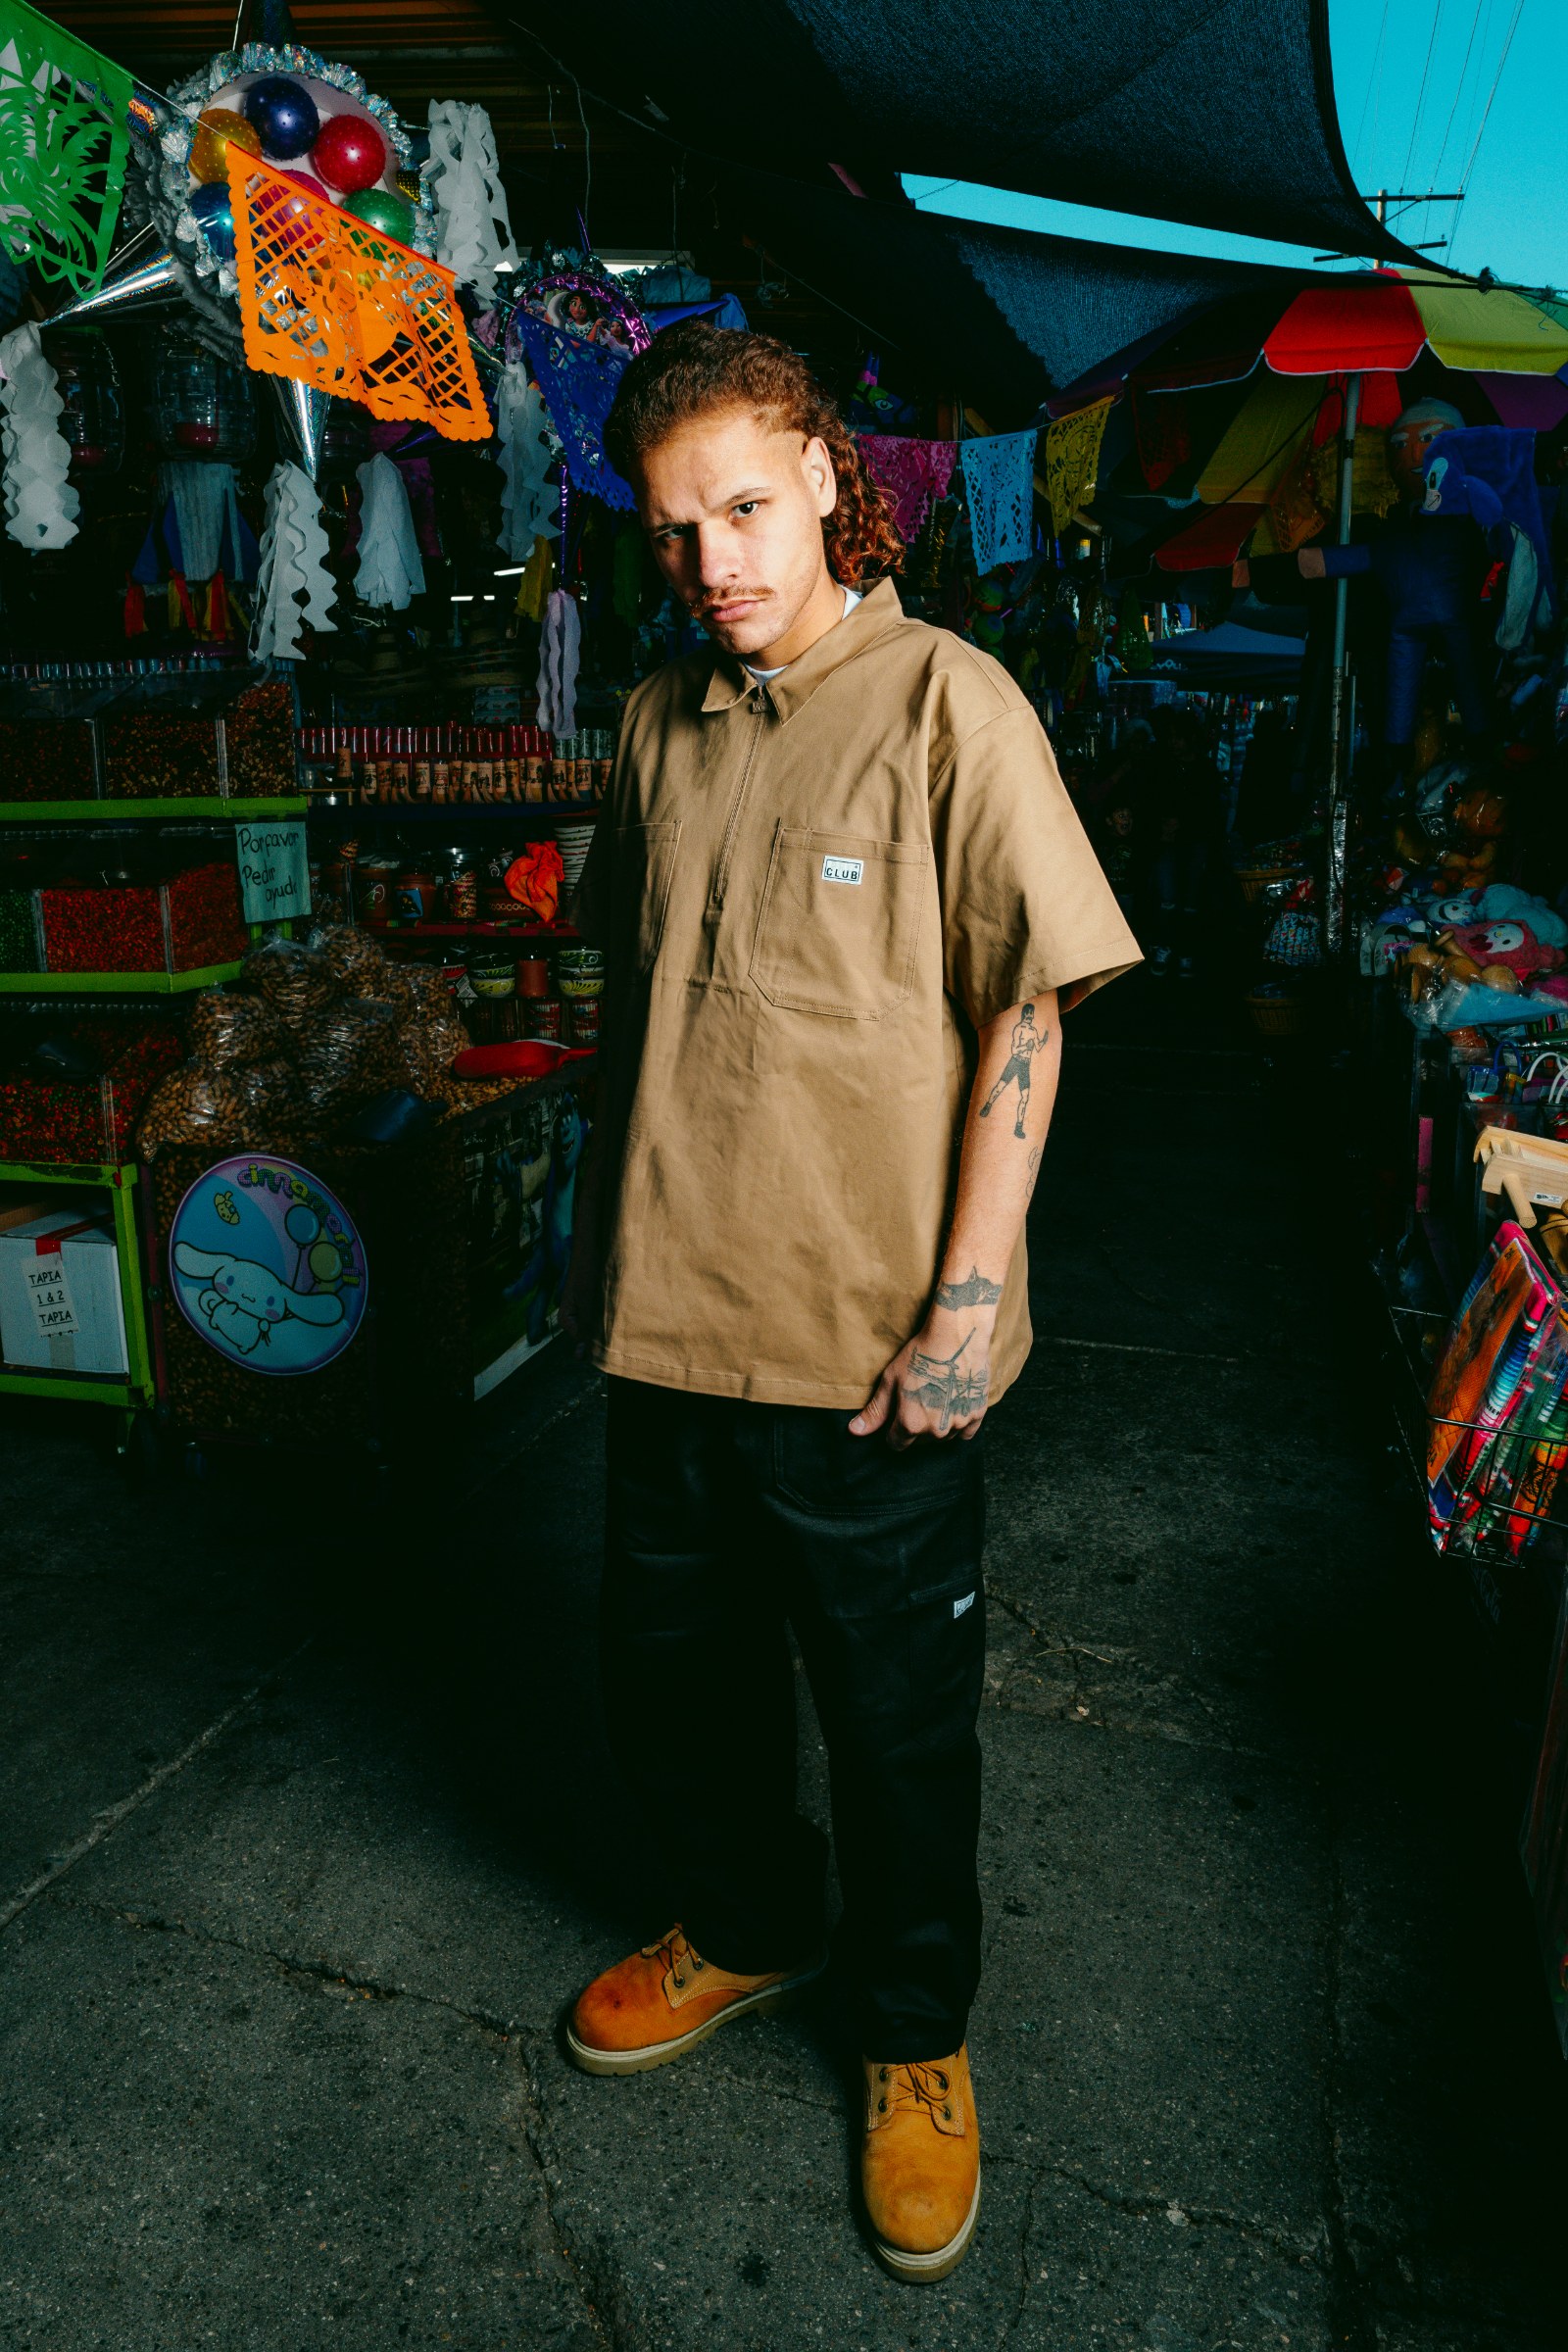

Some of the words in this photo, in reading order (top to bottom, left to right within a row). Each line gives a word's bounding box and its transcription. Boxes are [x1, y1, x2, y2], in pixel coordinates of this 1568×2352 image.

[242, 859, 275, 888] Pedir
[826, 867, 858, 880] CLUB
[28, 1270, 62, 1285] TAPIA
[37, 1294, 42, 1304] 1
[47, 1292, 54, 1302] &
[57, 1290, 64, 1300] 2
[39, 1310, 73, 1324] TAPIA
